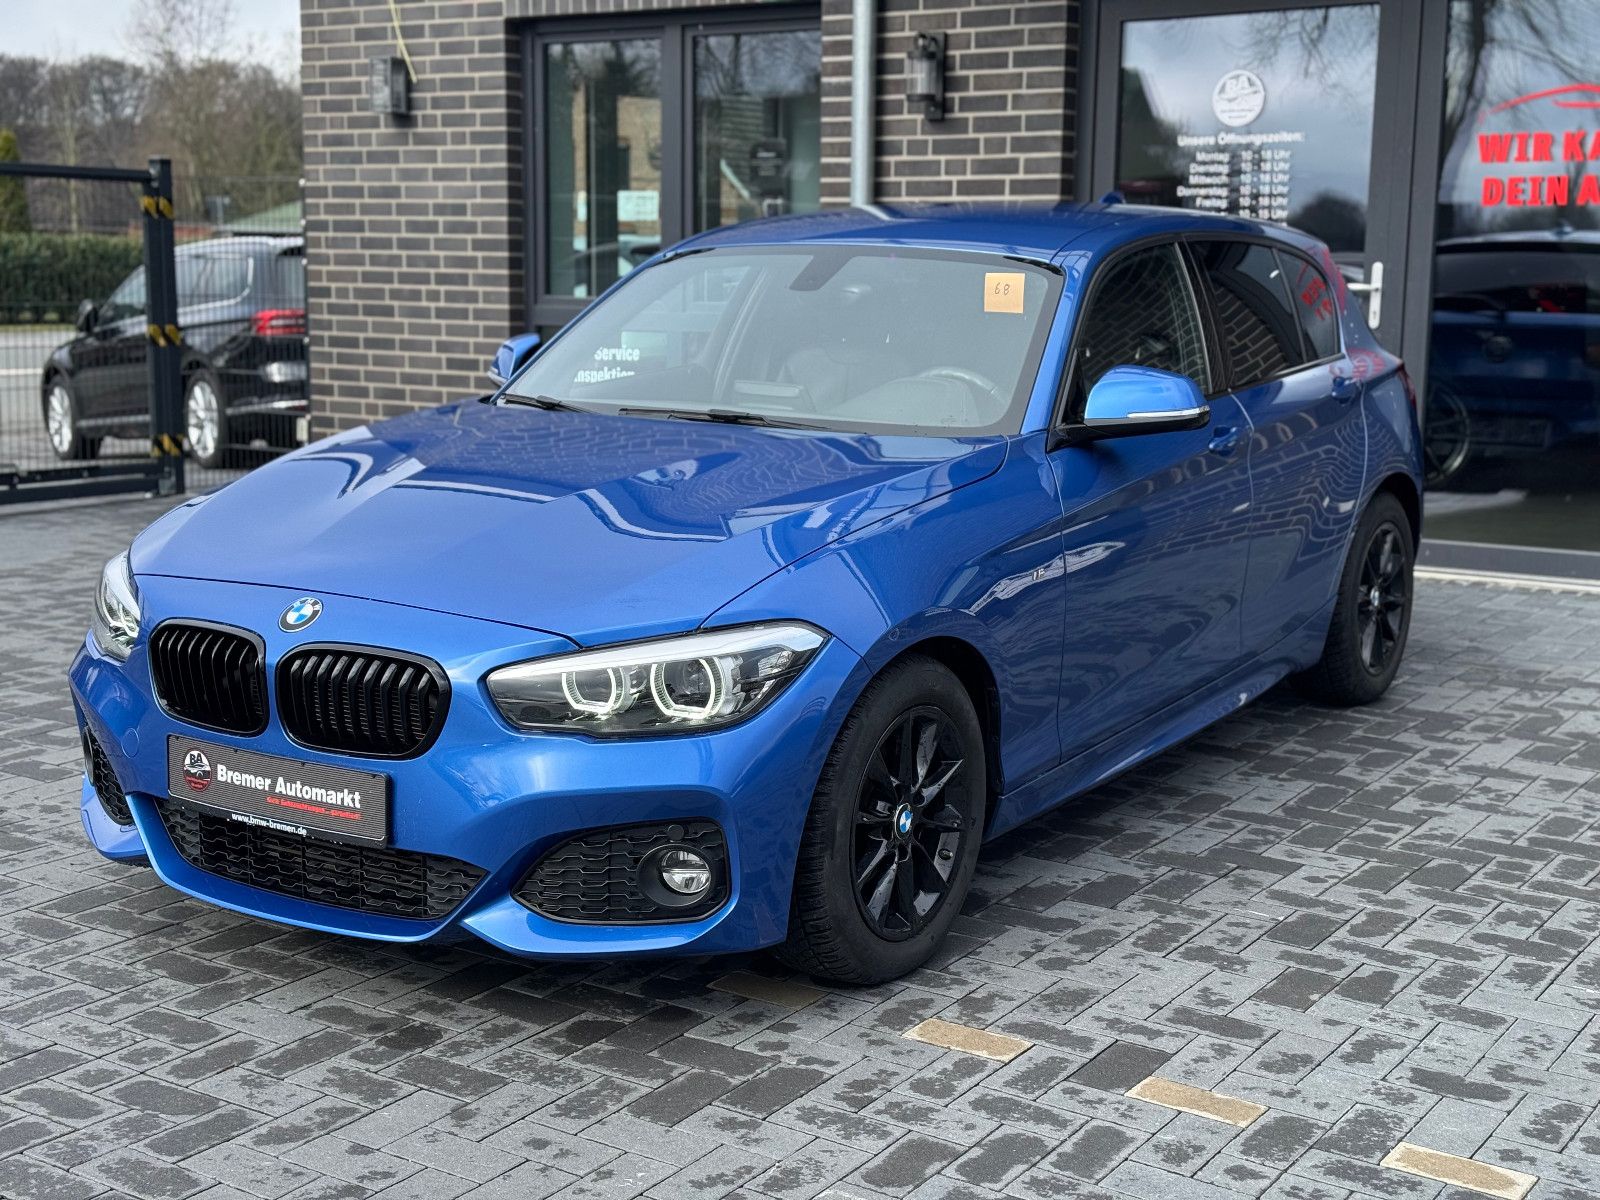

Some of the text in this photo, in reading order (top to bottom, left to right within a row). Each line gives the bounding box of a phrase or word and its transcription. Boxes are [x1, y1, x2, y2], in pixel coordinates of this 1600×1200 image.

[1478, 131, 1554, 164] WIR
[1481, 175, 1570, 208] DEIN
[594, 344, 641, 362] Service
[189, 753, 204, 765] BA
[216, 764, 273, 791] Bremer
[274, 777, 362, 809] Automarkt
[231, 813, 308, 836] www.bmw-bremen.de
